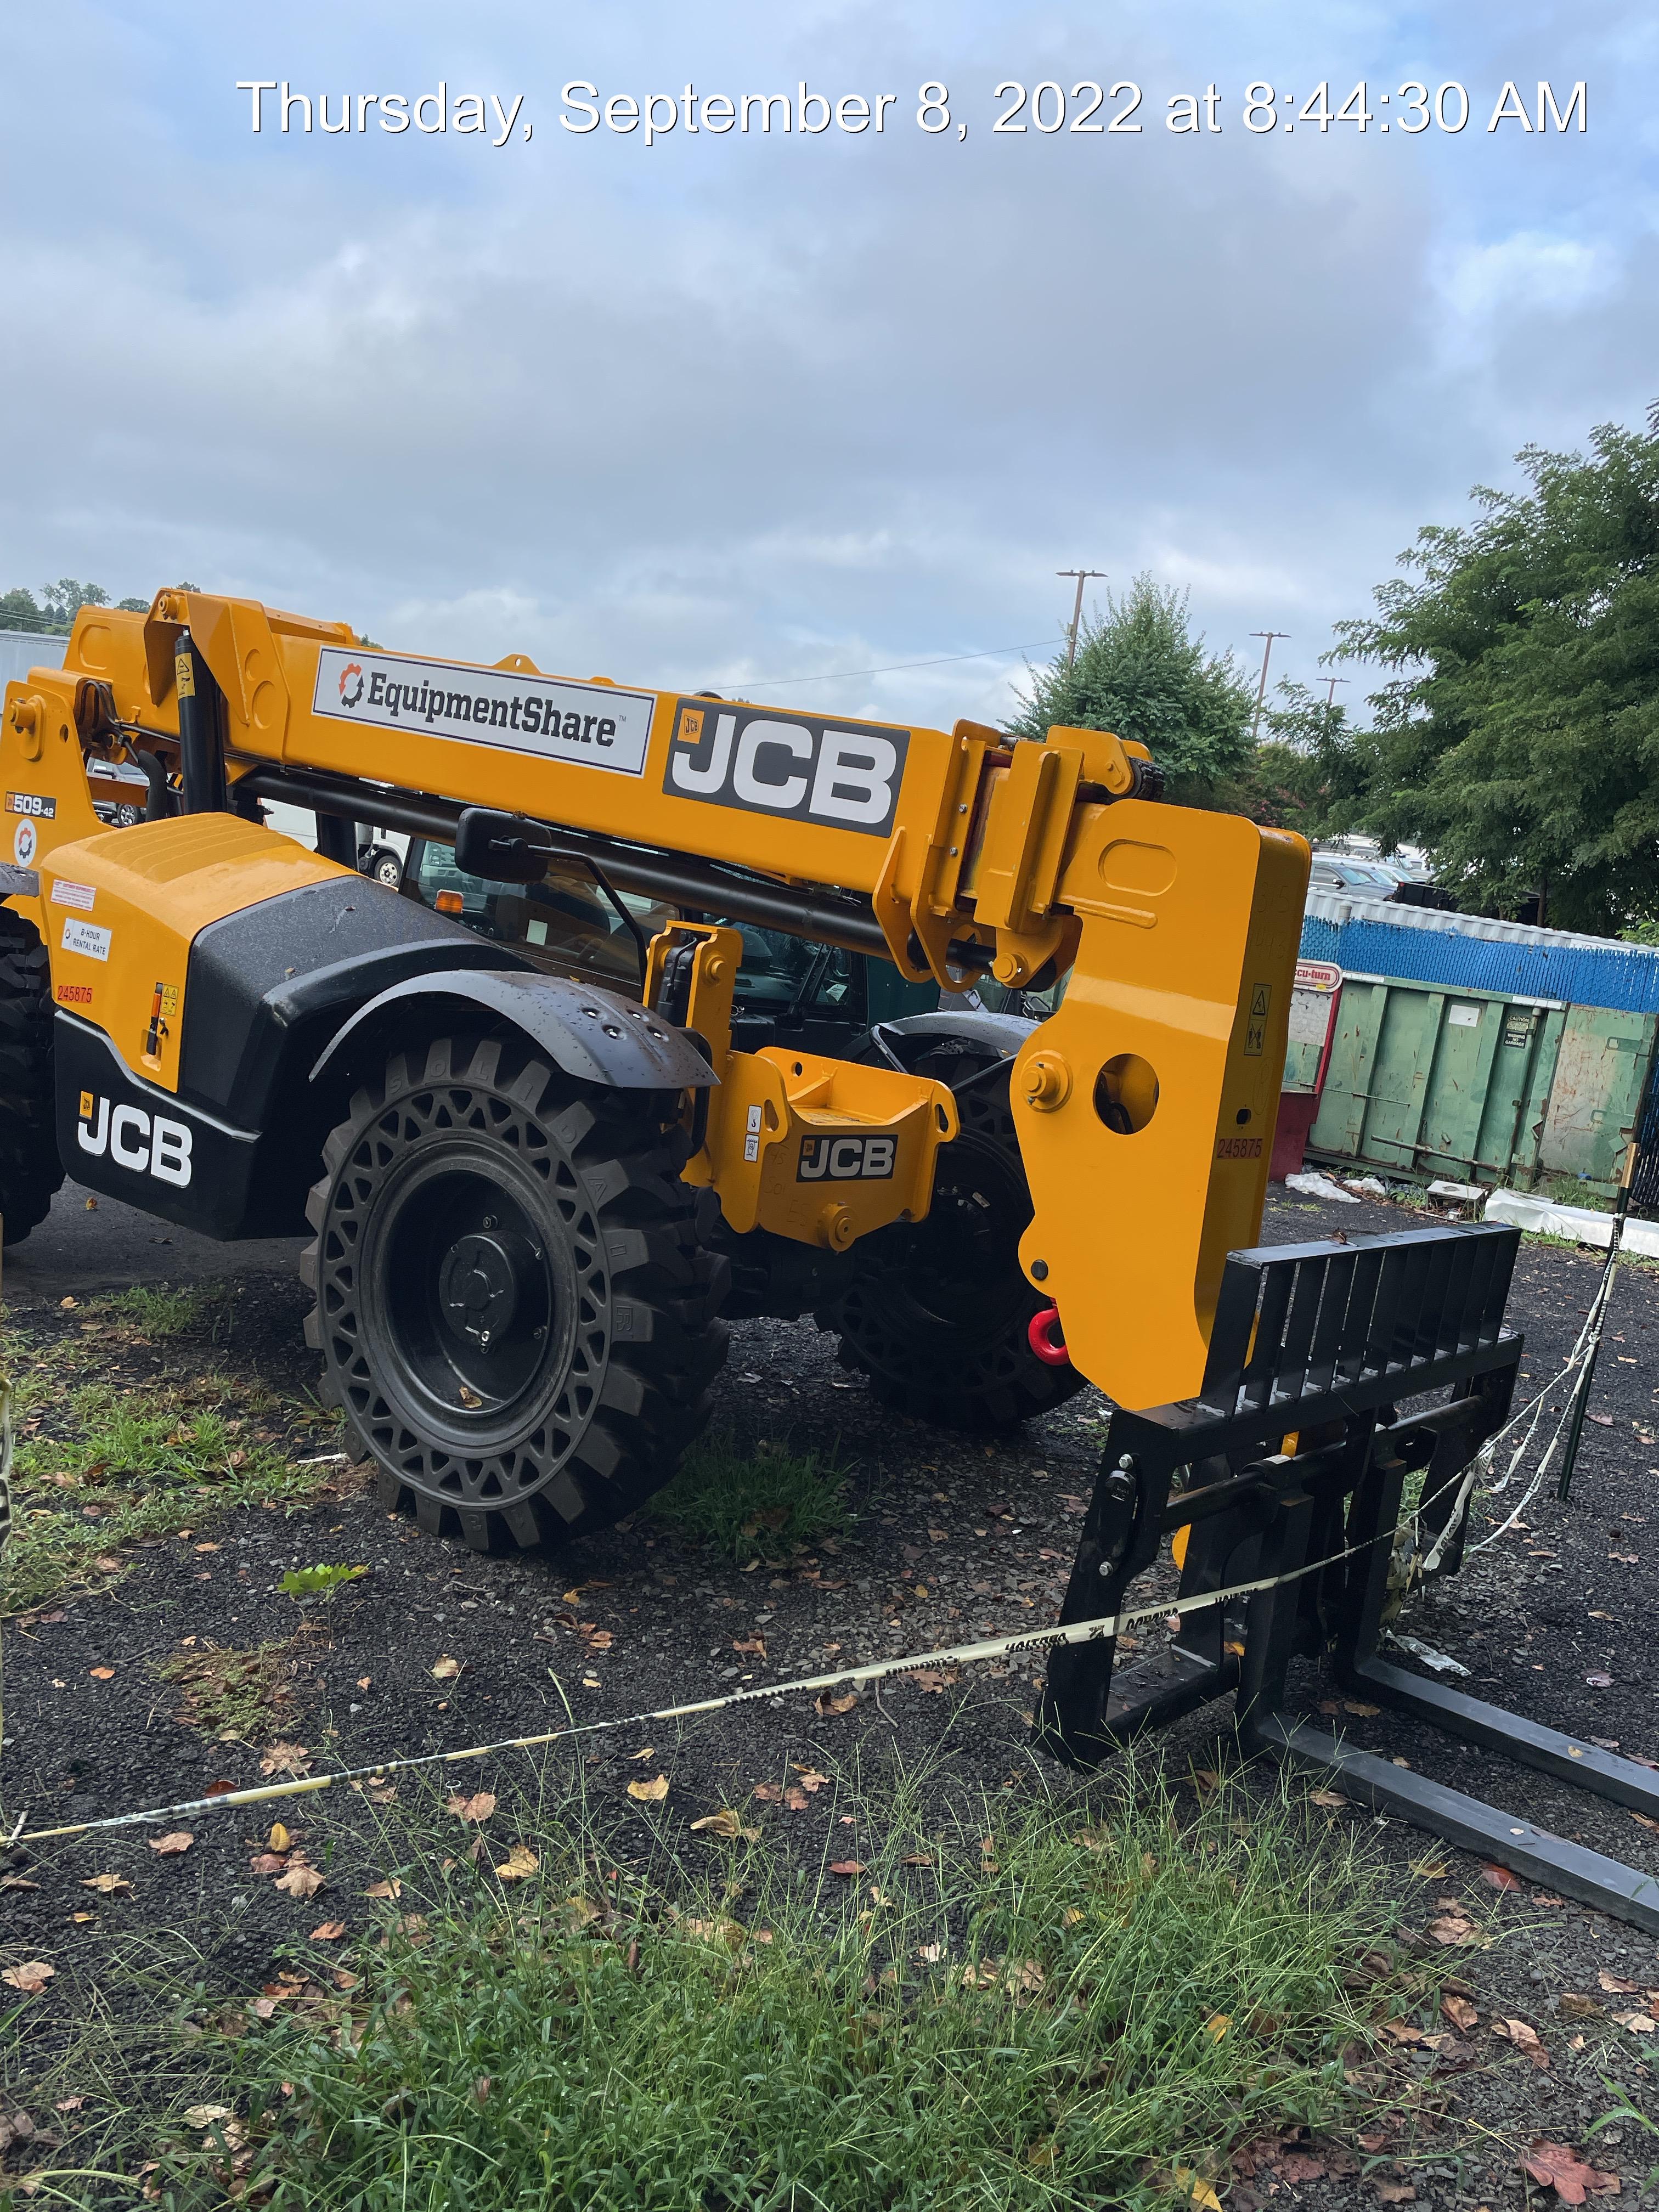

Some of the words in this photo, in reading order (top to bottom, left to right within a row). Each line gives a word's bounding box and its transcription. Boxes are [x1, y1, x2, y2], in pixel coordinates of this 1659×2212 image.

[366, 672, 616, 747] EquipmentShare
[672, 713, 897, 824] JCB
[72, 938, 91, 951] RENTAL
[92, 944, 106, 955] RATE
[81, 928, 100, 941] 8-HOUR
[58, 985, 92, 1003] 245875
[78, 1097, 193, 1188] JCB
[1217, 1137, 1263, 1159] 245875
[800, 1139, 894, 1178] JCB
